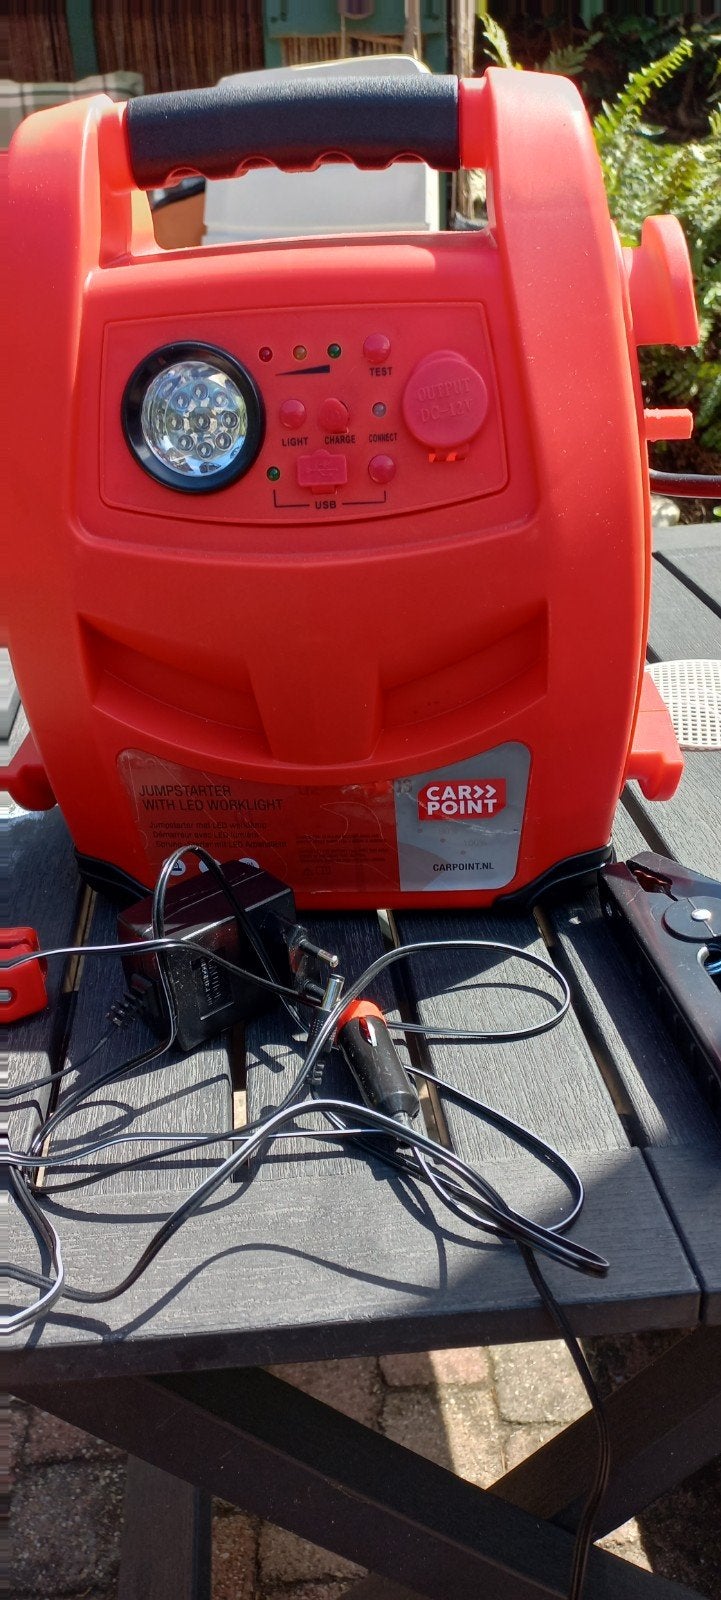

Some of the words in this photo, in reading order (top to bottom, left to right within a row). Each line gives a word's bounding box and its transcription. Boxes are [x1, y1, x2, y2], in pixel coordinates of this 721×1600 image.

[369, 366, 393, 377] TEST
[417, 378, 472, 400] OUTPUT
[281, 436, 309, 446] LIGHT
[324, 435, 356, 445] CHARGE
[368, 433, 398, 443] CONNECT
[315, 500, 337, 509] USB
[139, 784, 232, 797] JUMPSTARTER
[143, 799, 175, 811] WITH
[179, 799, 204, 811] LED
[207, 798, 283, 811] WORKLIGHT
[426, 799, 498, 816] POINT
[432, 862, 494, 872] CARPOINT.NL
